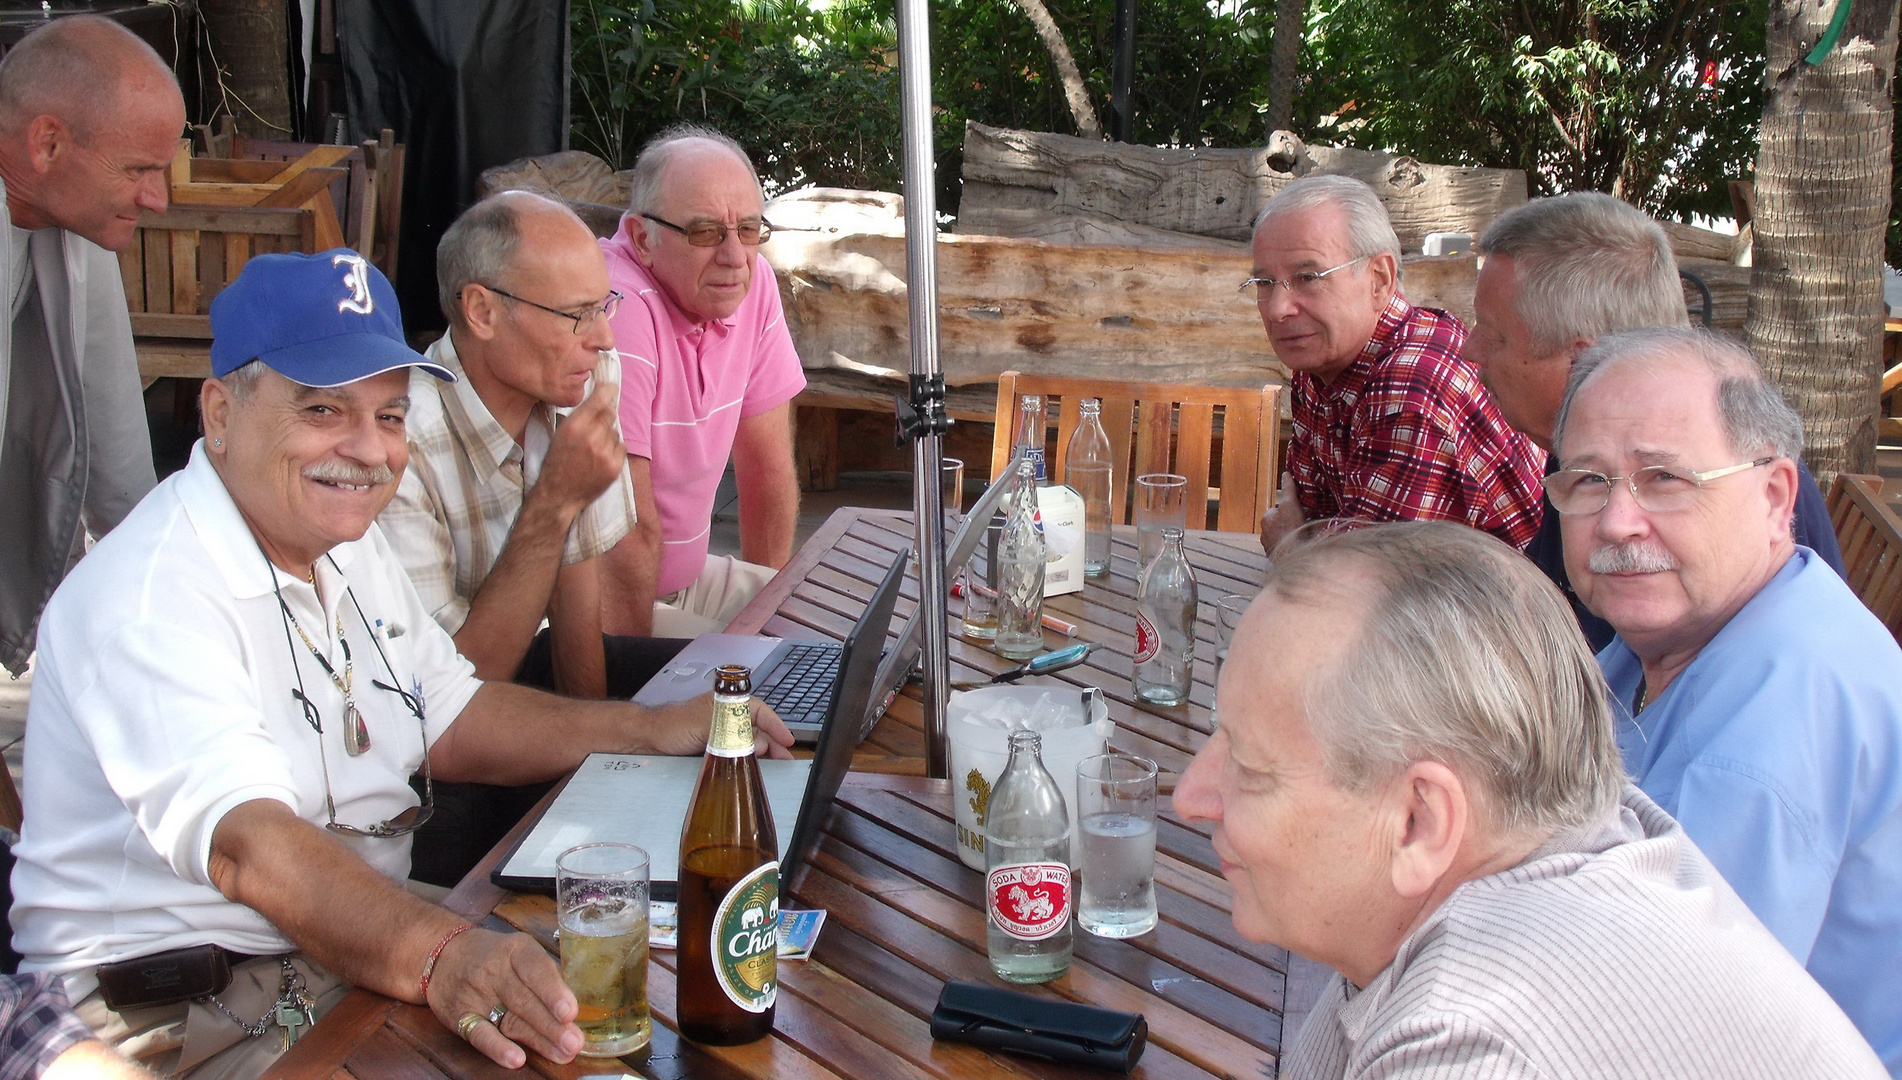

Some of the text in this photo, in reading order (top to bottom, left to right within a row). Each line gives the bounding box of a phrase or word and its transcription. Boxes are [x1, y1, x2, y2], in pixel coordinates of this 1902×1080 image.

[957, 823, 984, 853] SIN
[992, 871, 1069, 888] SODA WATER
